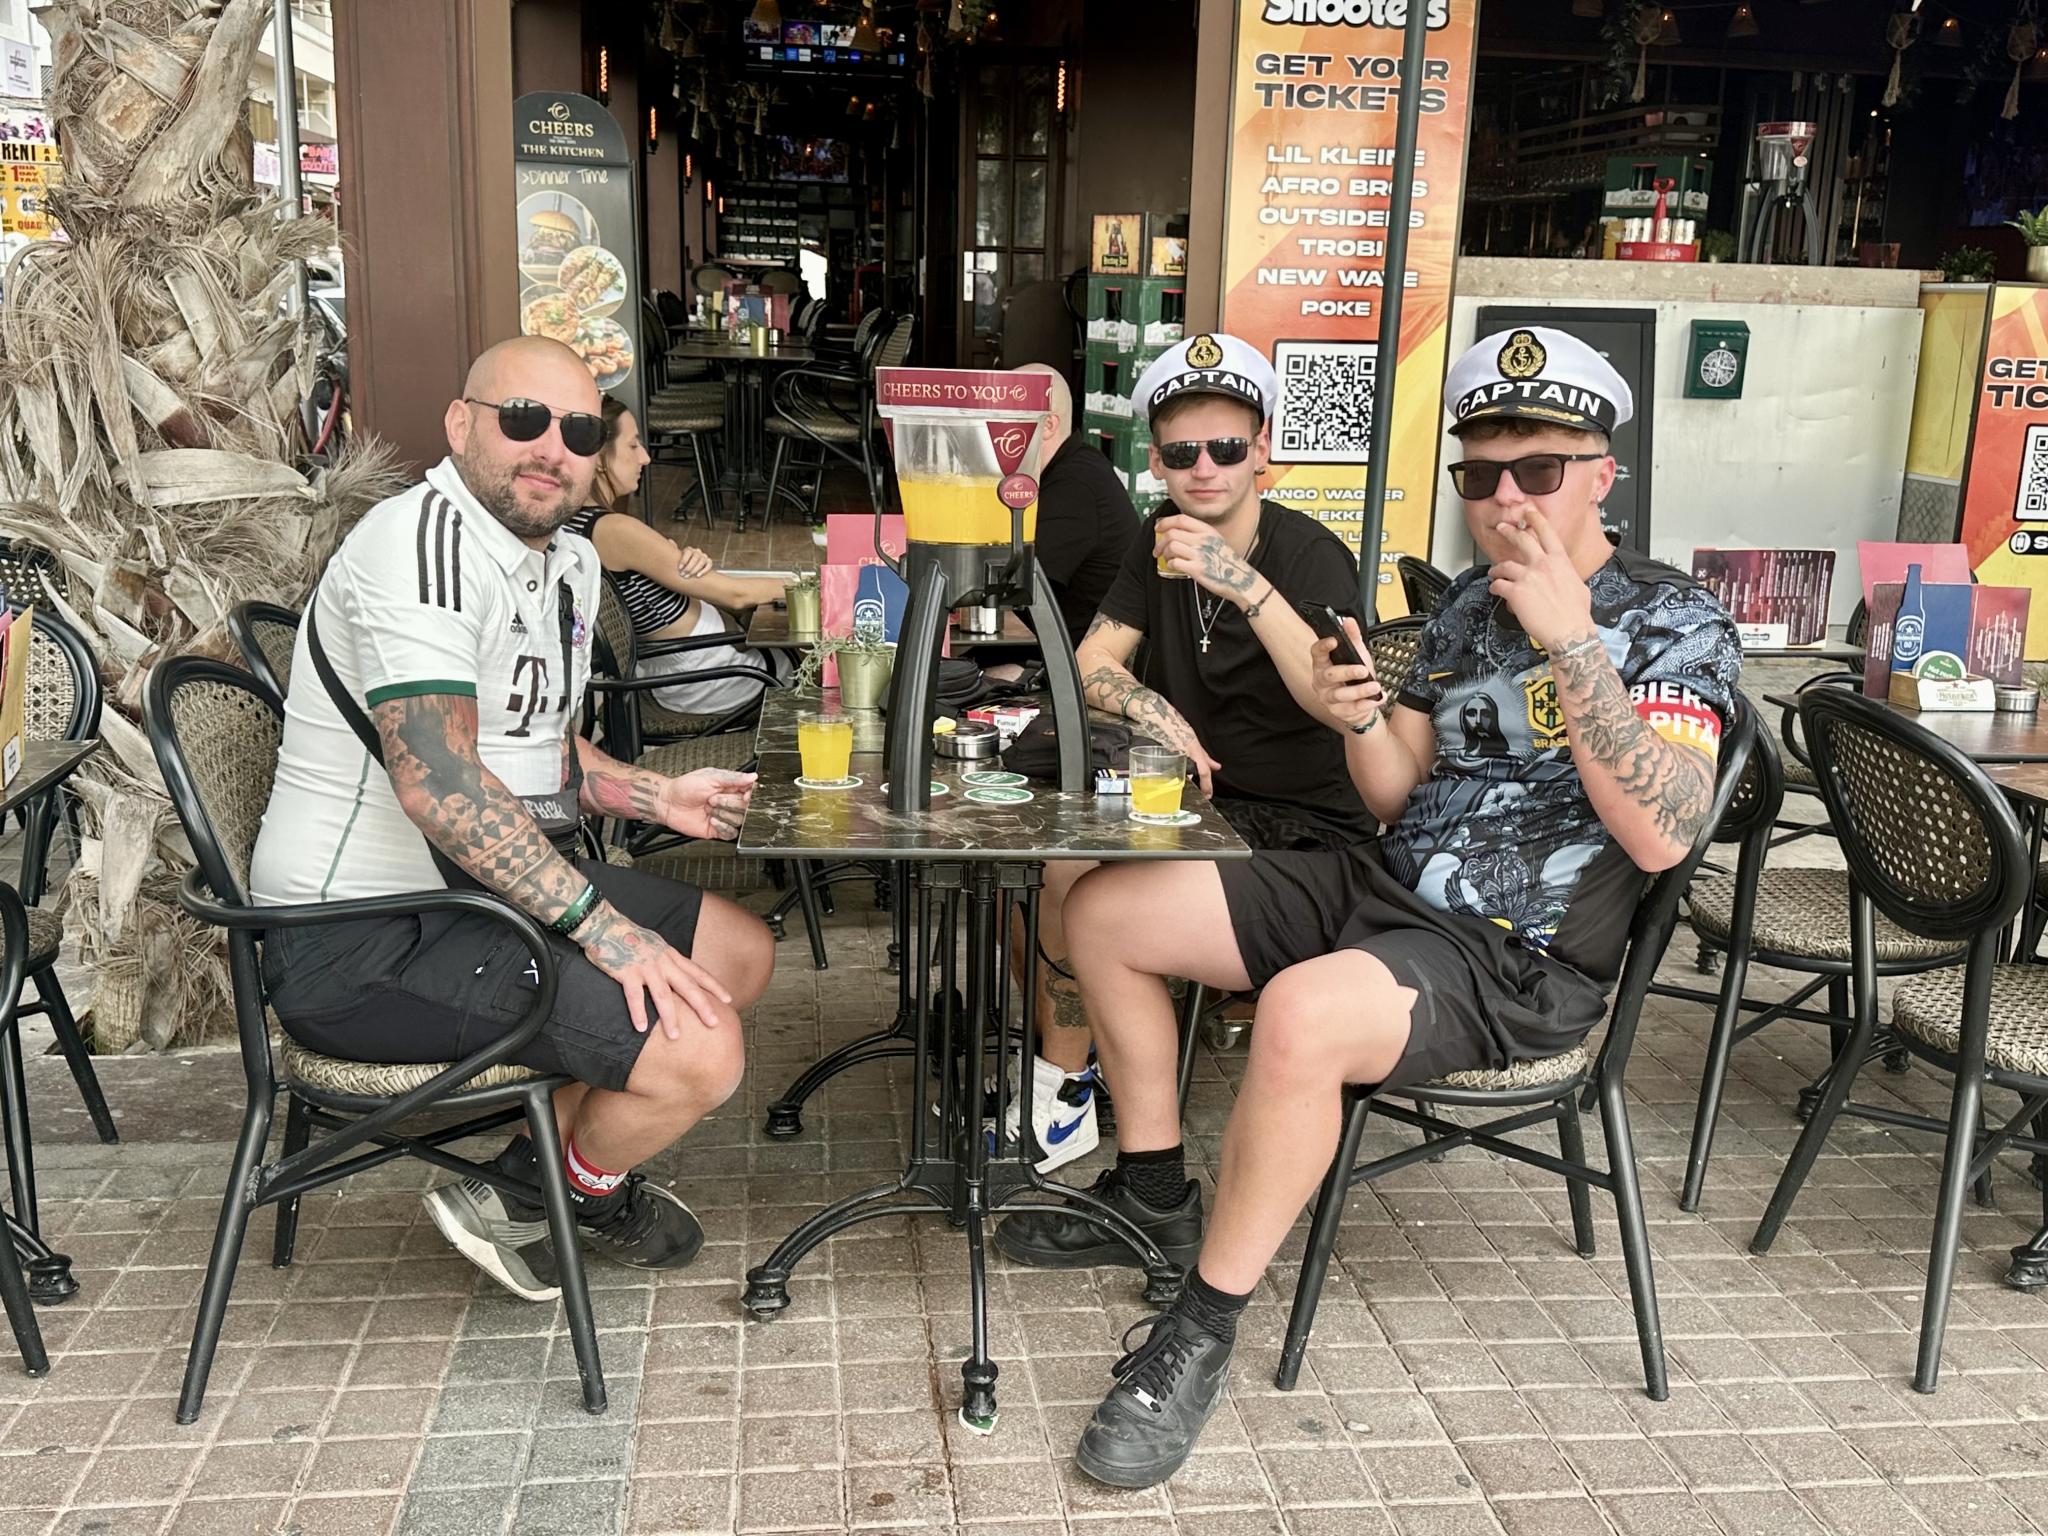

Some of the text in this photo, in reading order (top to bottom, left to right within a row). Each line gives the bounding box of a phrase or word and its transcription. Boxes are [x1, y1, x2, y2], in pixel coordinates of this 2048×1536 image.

[1264, 0, 1448, 28] Shootes
[1256, 54, 1448, 80] GET YOR
[529, 120, 594, 137] CHEERS
[521, 144, 604, 158] THE KITCHEN
[1267, 146, 1425, 167] LIL KLEIE
[1261, 177, 1428, 198] AFRO BRS
[1298, 239, 1383, 257] TROBI
[1258, 269, 1326, 286] NEW
[1302, 301, 1370, 316] POKE
[883, 383, 1007, 402] CHEERS TO YOU
[1154, 371, 1259, 405] CAPTAIN
[1458, 381, 1601, 417] CAPTAIN
[1004, 490, 1034, 500] CHEERS
[1258, 488, 1404, 500] JANGO WAGER
[1318, 510, 1364, 521] EKKE
[1630, 681, 1712, 712] BIER-
[1649, 711, 1719, 746] PITÄ
